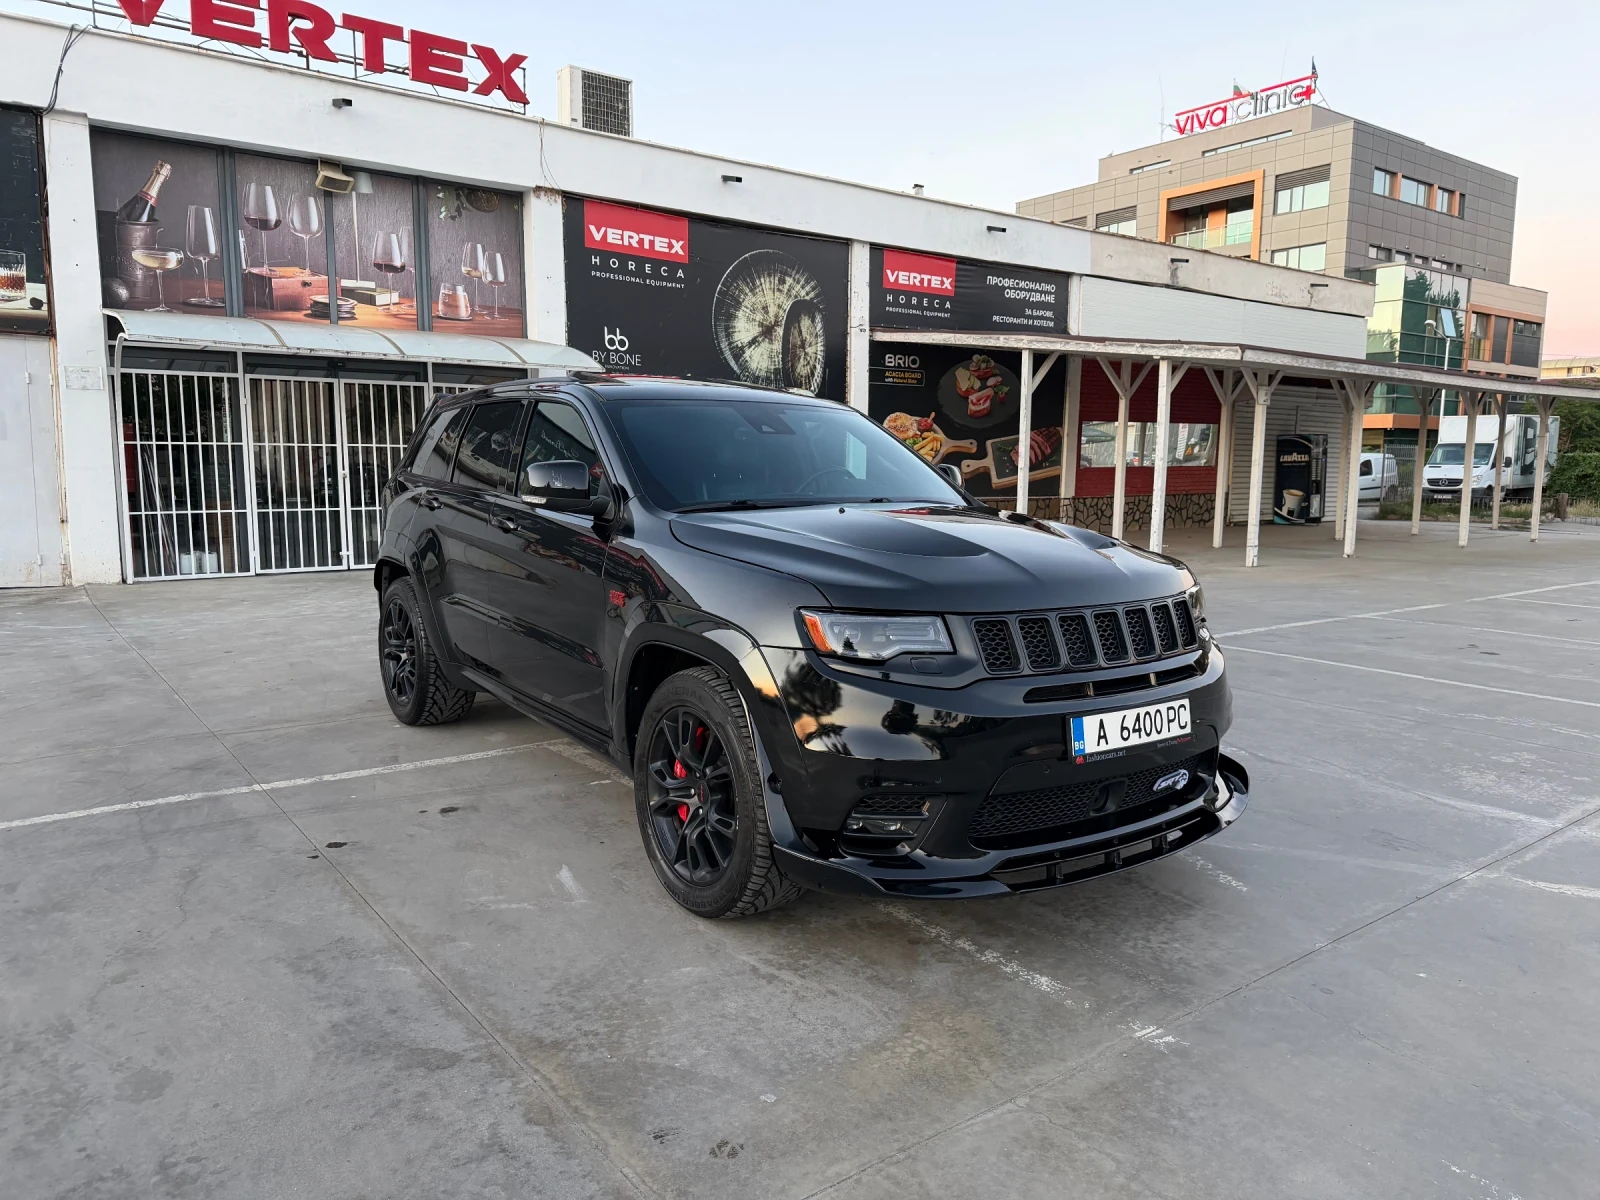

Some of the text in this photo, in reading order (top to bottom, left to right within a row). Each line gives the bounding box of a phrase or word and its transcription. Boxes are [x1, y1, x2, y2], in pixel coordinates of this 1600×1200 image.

[1175, 105, 1228, 136] viva
[588, 224, 685, 256] VERTEX
[591, 255, 685, 279] HORECA
[591, 270, 685, 289] PROFESSIONAL EQUIPMENT
[886, 269, 952, 289] VERTEX
[987, 276, 1055, 292] ПРОФЕСИОНАЛНО
[887, 294, 950, 309] HORECA
[1005, 289, 1055, 303] ОБОРУДВАНЕ
[886, 306, 922, 315] PROFESSIONAL
[1033, 309, 1054, 318] БАРОВЕ,
[993, 315, 1027, 324] РЕСТОРАНТИ
[593, 350, 641, 366] BY BONE
[885, 354, 919, 368] BRIO
[1096, 718, 1109, 747] A
[1074, 741, 1085, 751] BG
